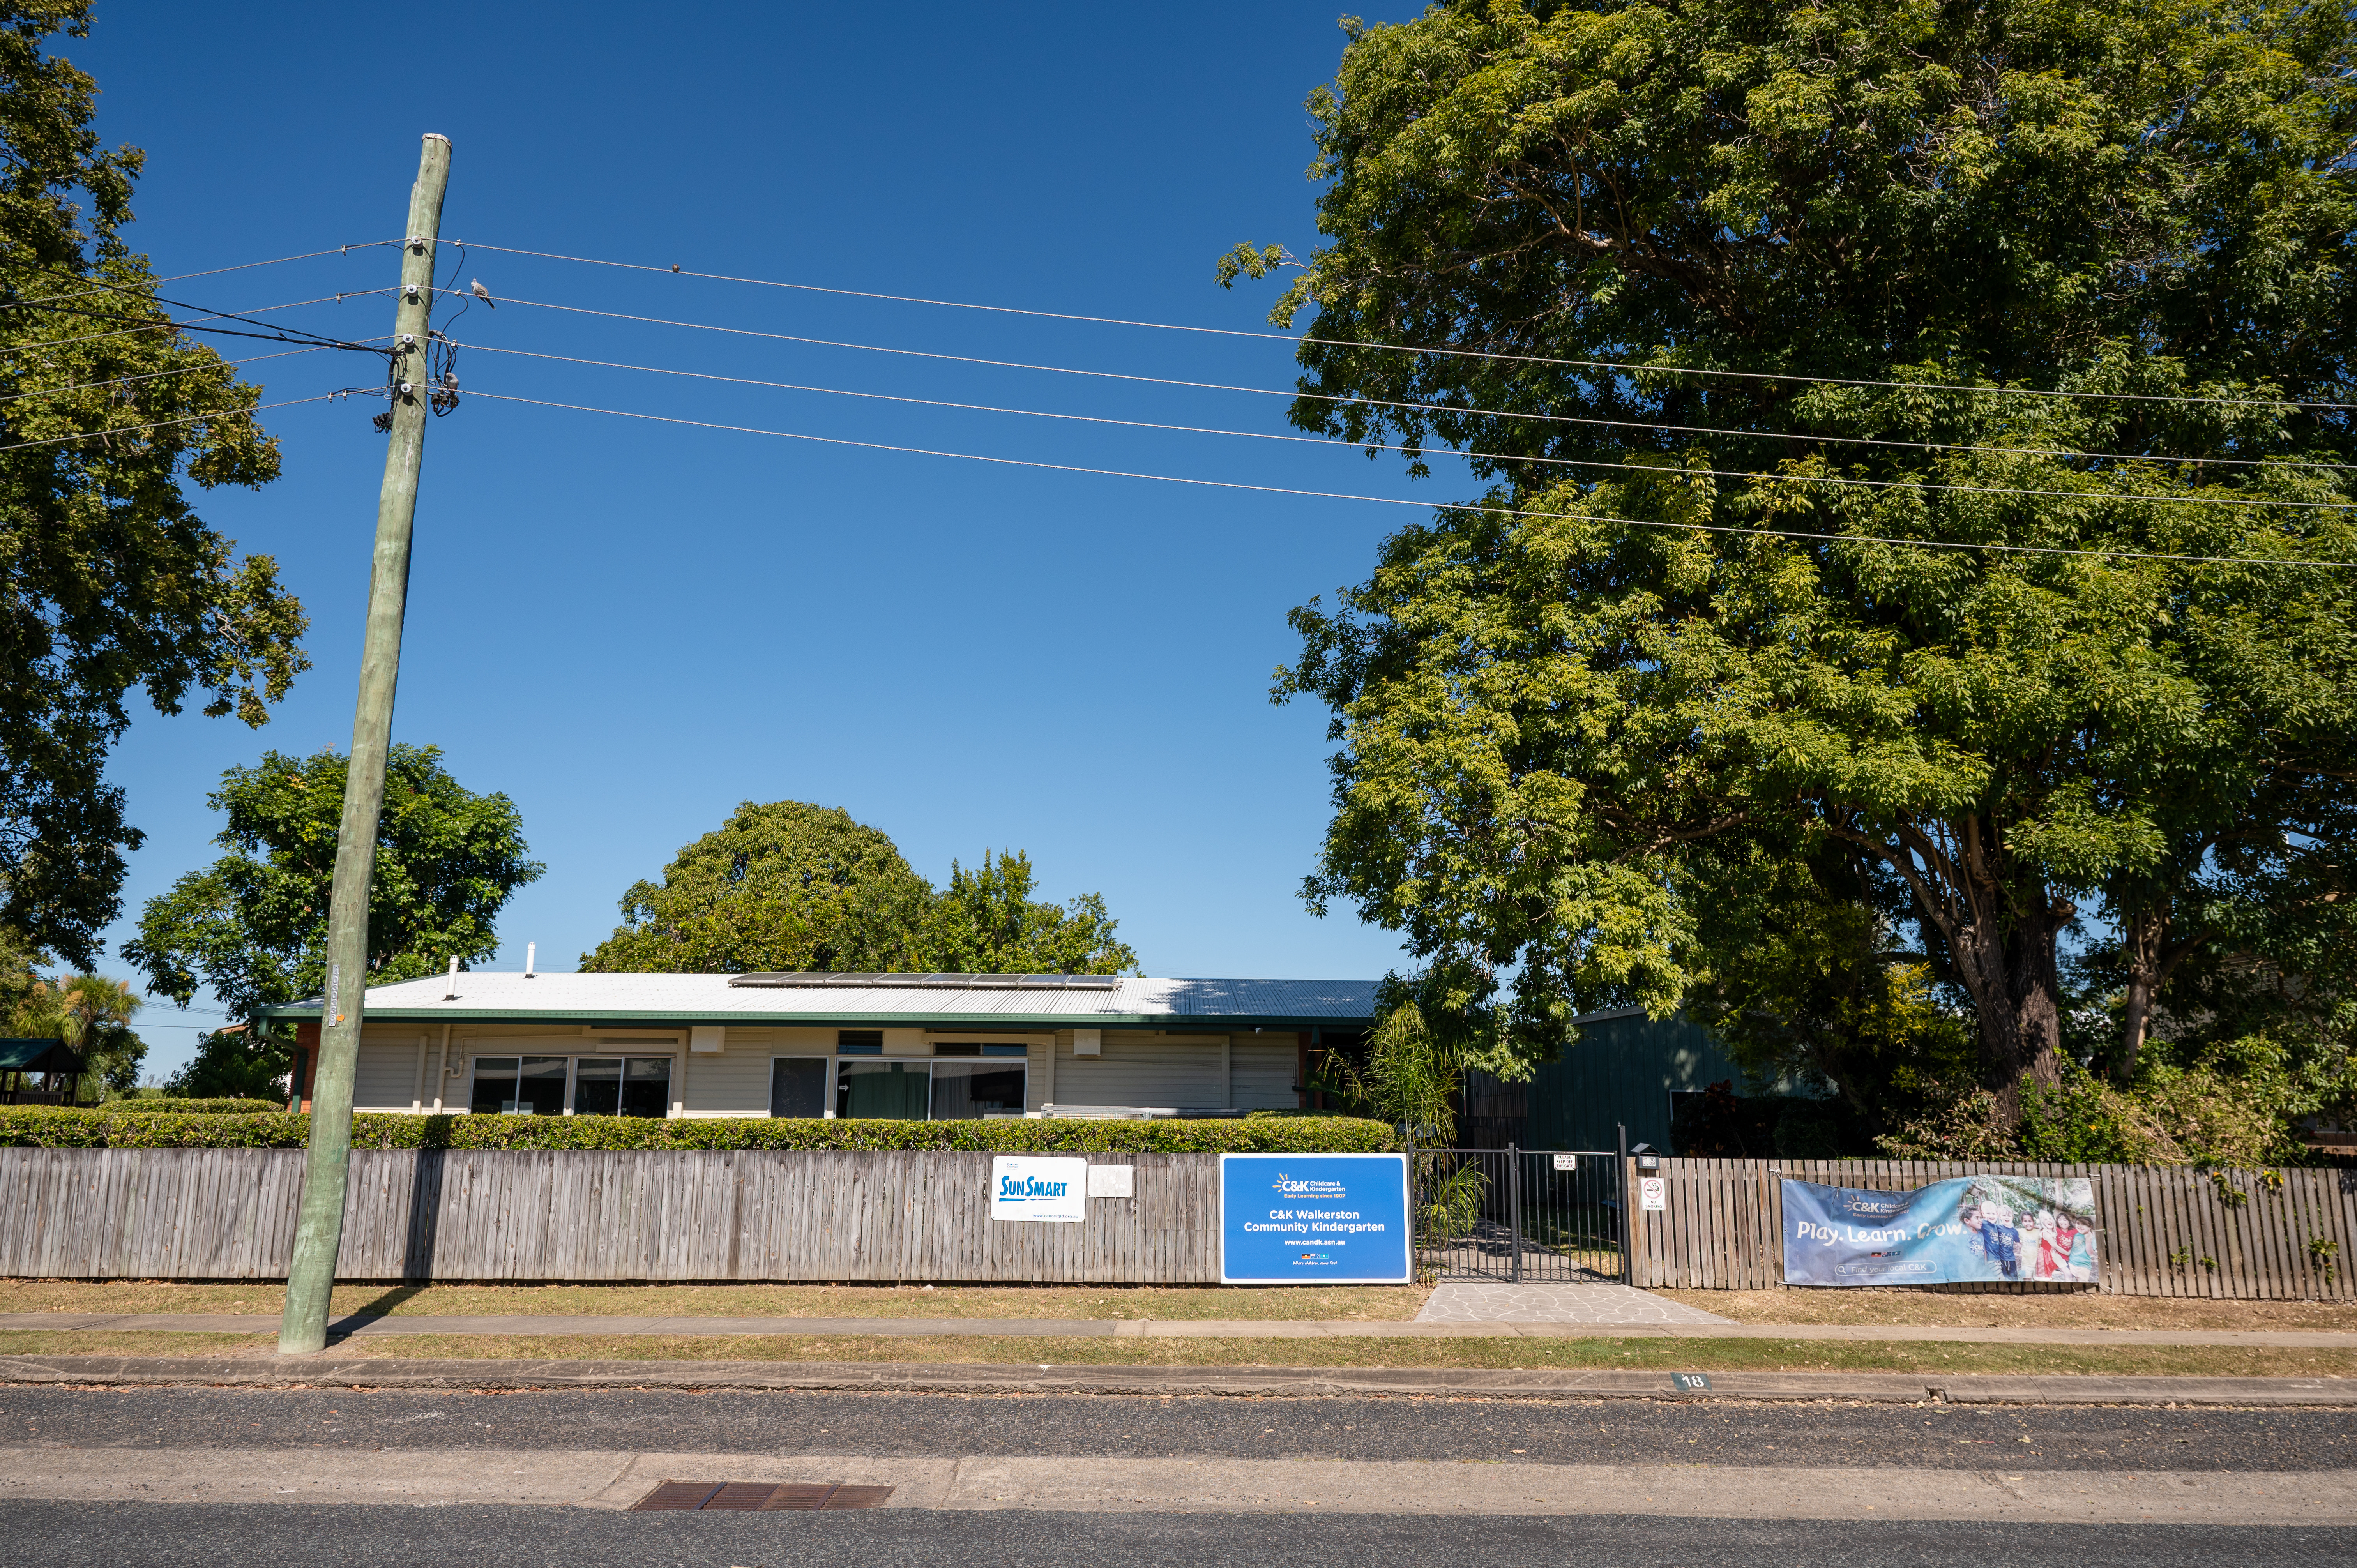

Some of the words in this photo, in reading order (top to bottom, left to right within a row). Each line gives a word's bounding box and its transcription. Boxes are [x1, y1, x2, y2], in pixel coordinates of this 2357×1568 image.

[1643, 1158, 1656, 1166] 18
[1282, 1181, 1309, 1192] C&K
[1852, 1202, 1880, 1213] C&K
[1269, 1210, 1293, 1220] C&K
[1297, 1210, 1359, 1220] Walkerston
[1244, 1222, 1309, 1233] Community
[1312, 1222, 1385, 1233] Kindergarten
[1797, 1221, 1843, 1246] Play.
[1847, 1225, 1912, 1242] Learn.
[1917, 1223, 1967, 1239] Grow.
[1888, 1263, 1906, 1272] local
[1682, 1375, 1704, 1387] 18
